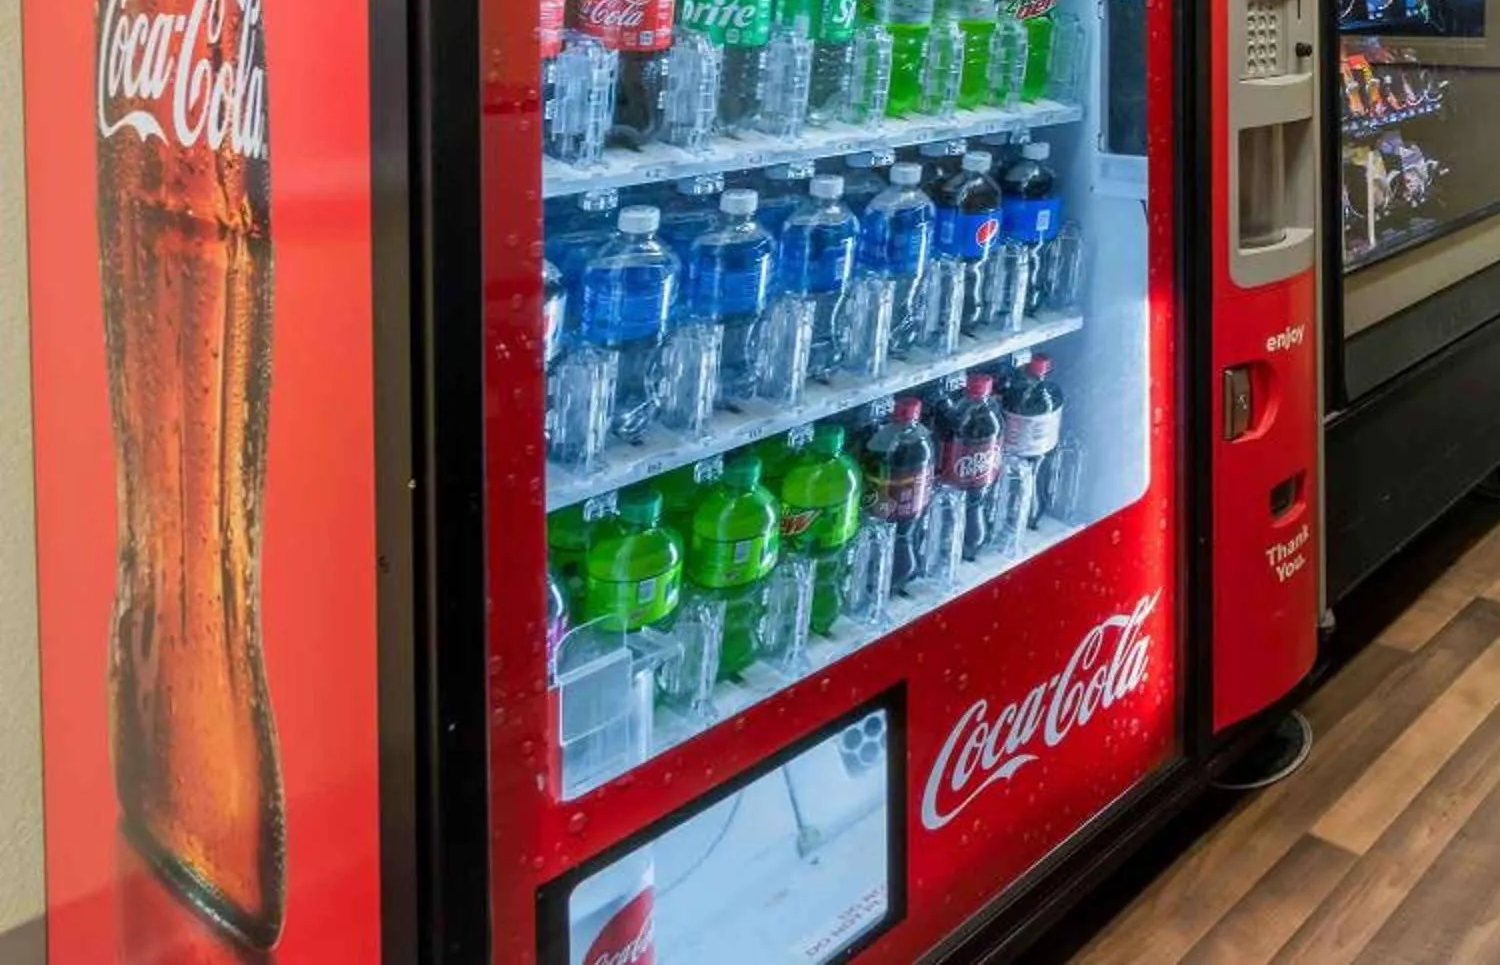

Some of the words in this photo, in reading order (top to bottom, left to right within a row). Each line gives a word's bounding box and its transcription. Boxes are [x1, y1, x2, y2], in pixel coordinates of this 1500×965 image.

[1265, 323, 1305, 352] enjoy
[1265, 523, 1309, 566] Thank
[920, 586, 1162, 831] Coca-Cola
